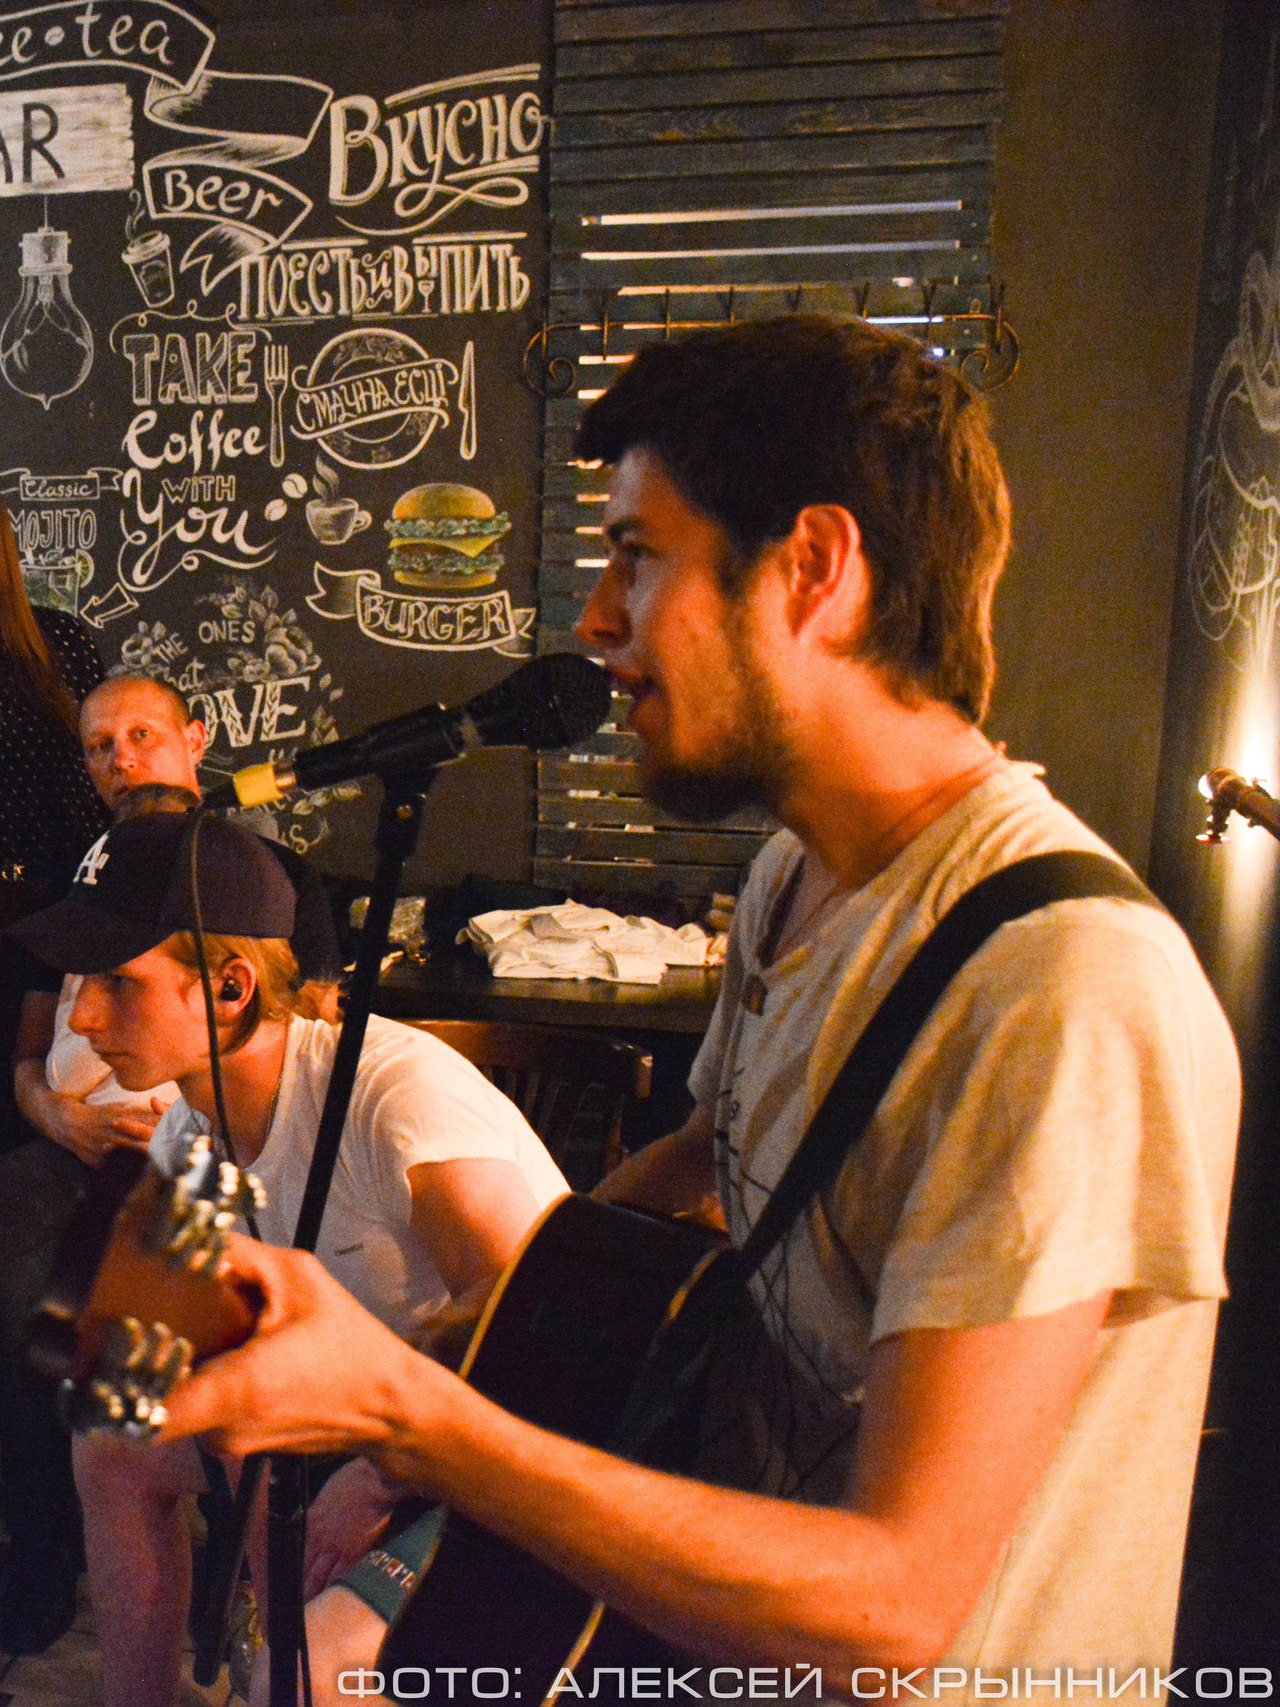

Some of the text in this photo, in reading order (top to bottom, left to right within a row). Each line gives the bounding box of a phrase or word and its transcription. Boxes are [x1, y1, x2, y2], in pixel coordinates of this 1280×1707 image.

[75, 1, 174, 65] tea
[164, 170, 284, 219] Beer
[238, 247, 367, 321] ПОЕСТЬ
[123, 332, 259, 405] TAKE
[122, 409, 268, 472] Coffee
[24, 479, 93, 498] Classic
[7, 508, 97, 550] MOJITO
[152, 620, 256, 664] THE ONES
